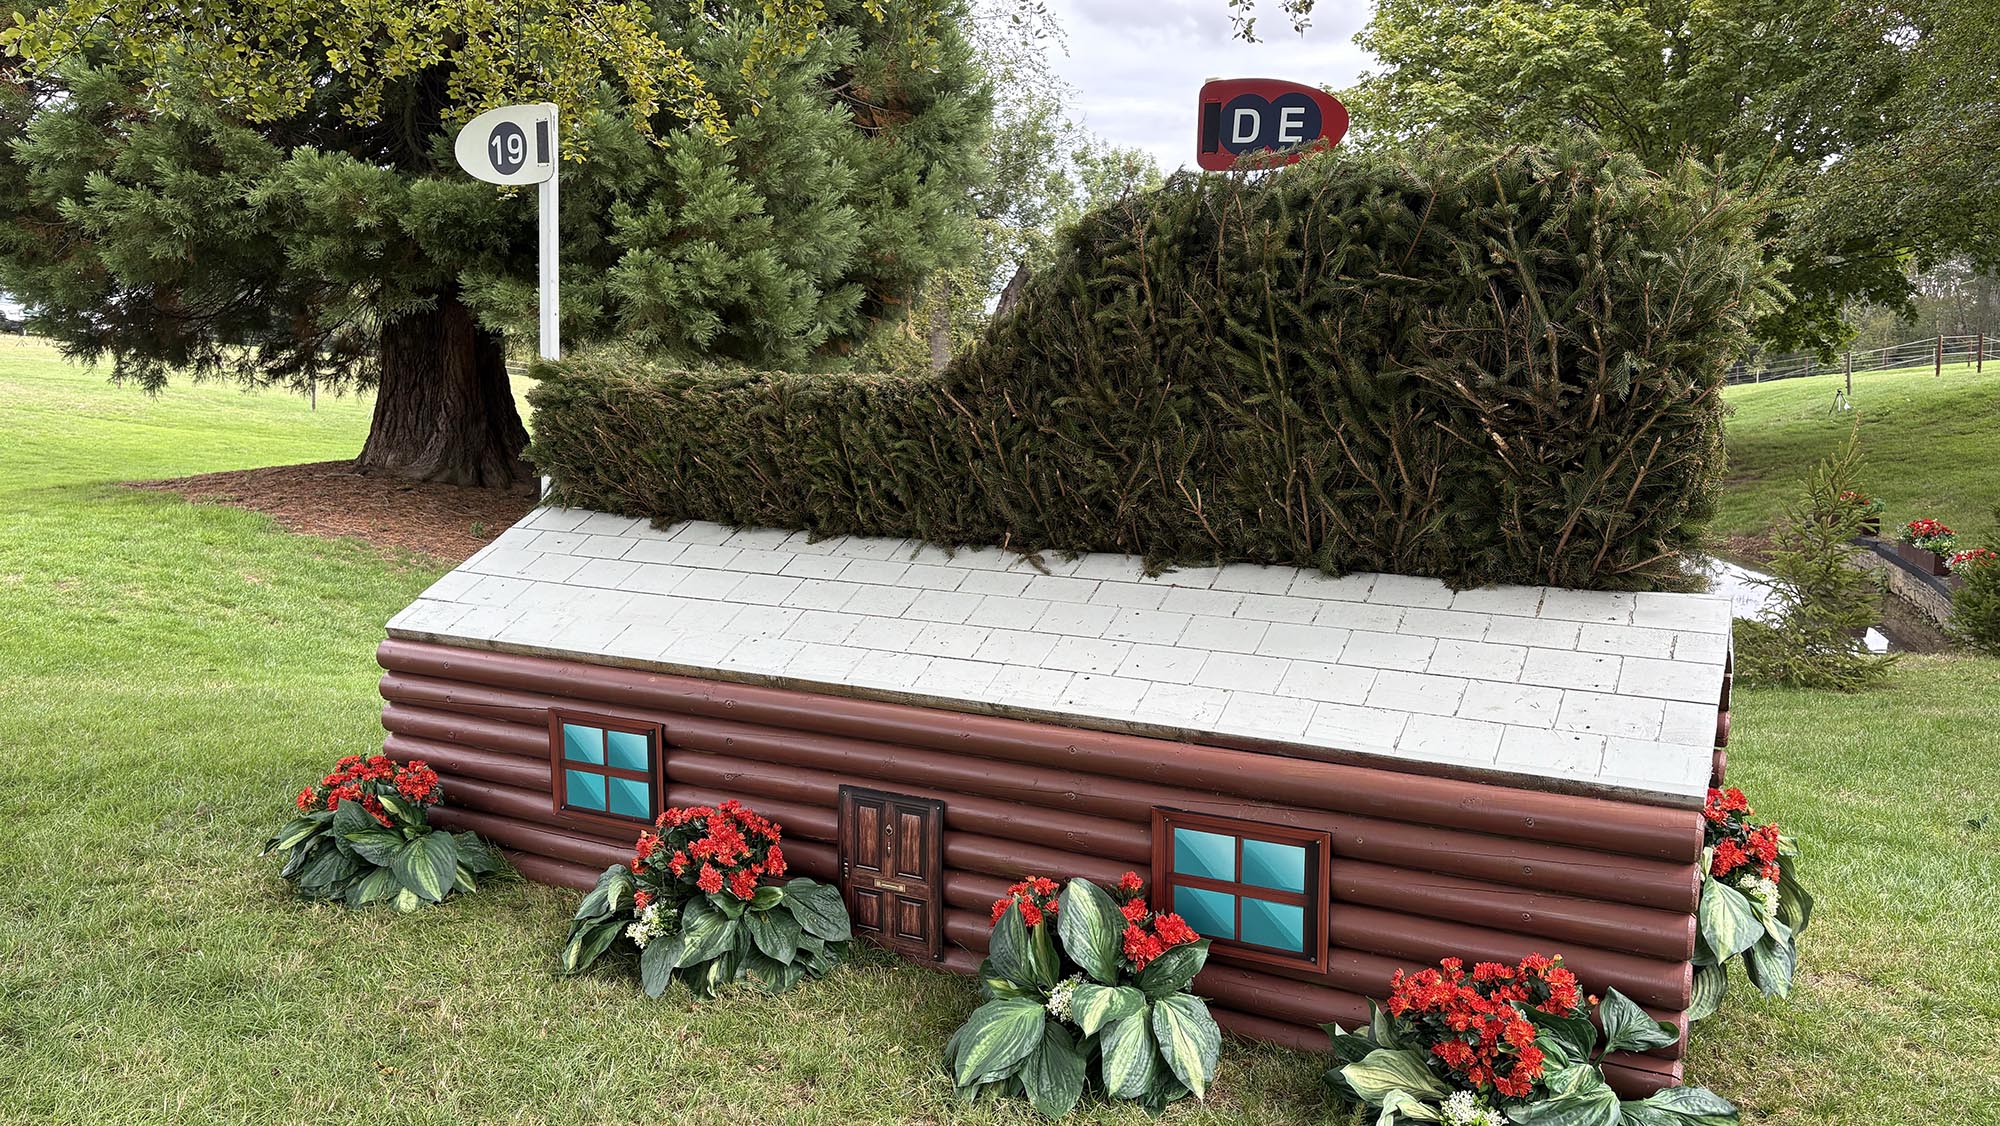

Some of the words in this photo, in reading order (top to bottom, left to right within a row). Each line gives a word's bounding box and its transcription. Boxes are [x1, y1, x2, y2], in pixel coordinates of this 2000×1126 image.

[1232, 108, 1261, 144] D
[1278, 107, 1306, 143] E
[491, 133, 523, 166] 19
